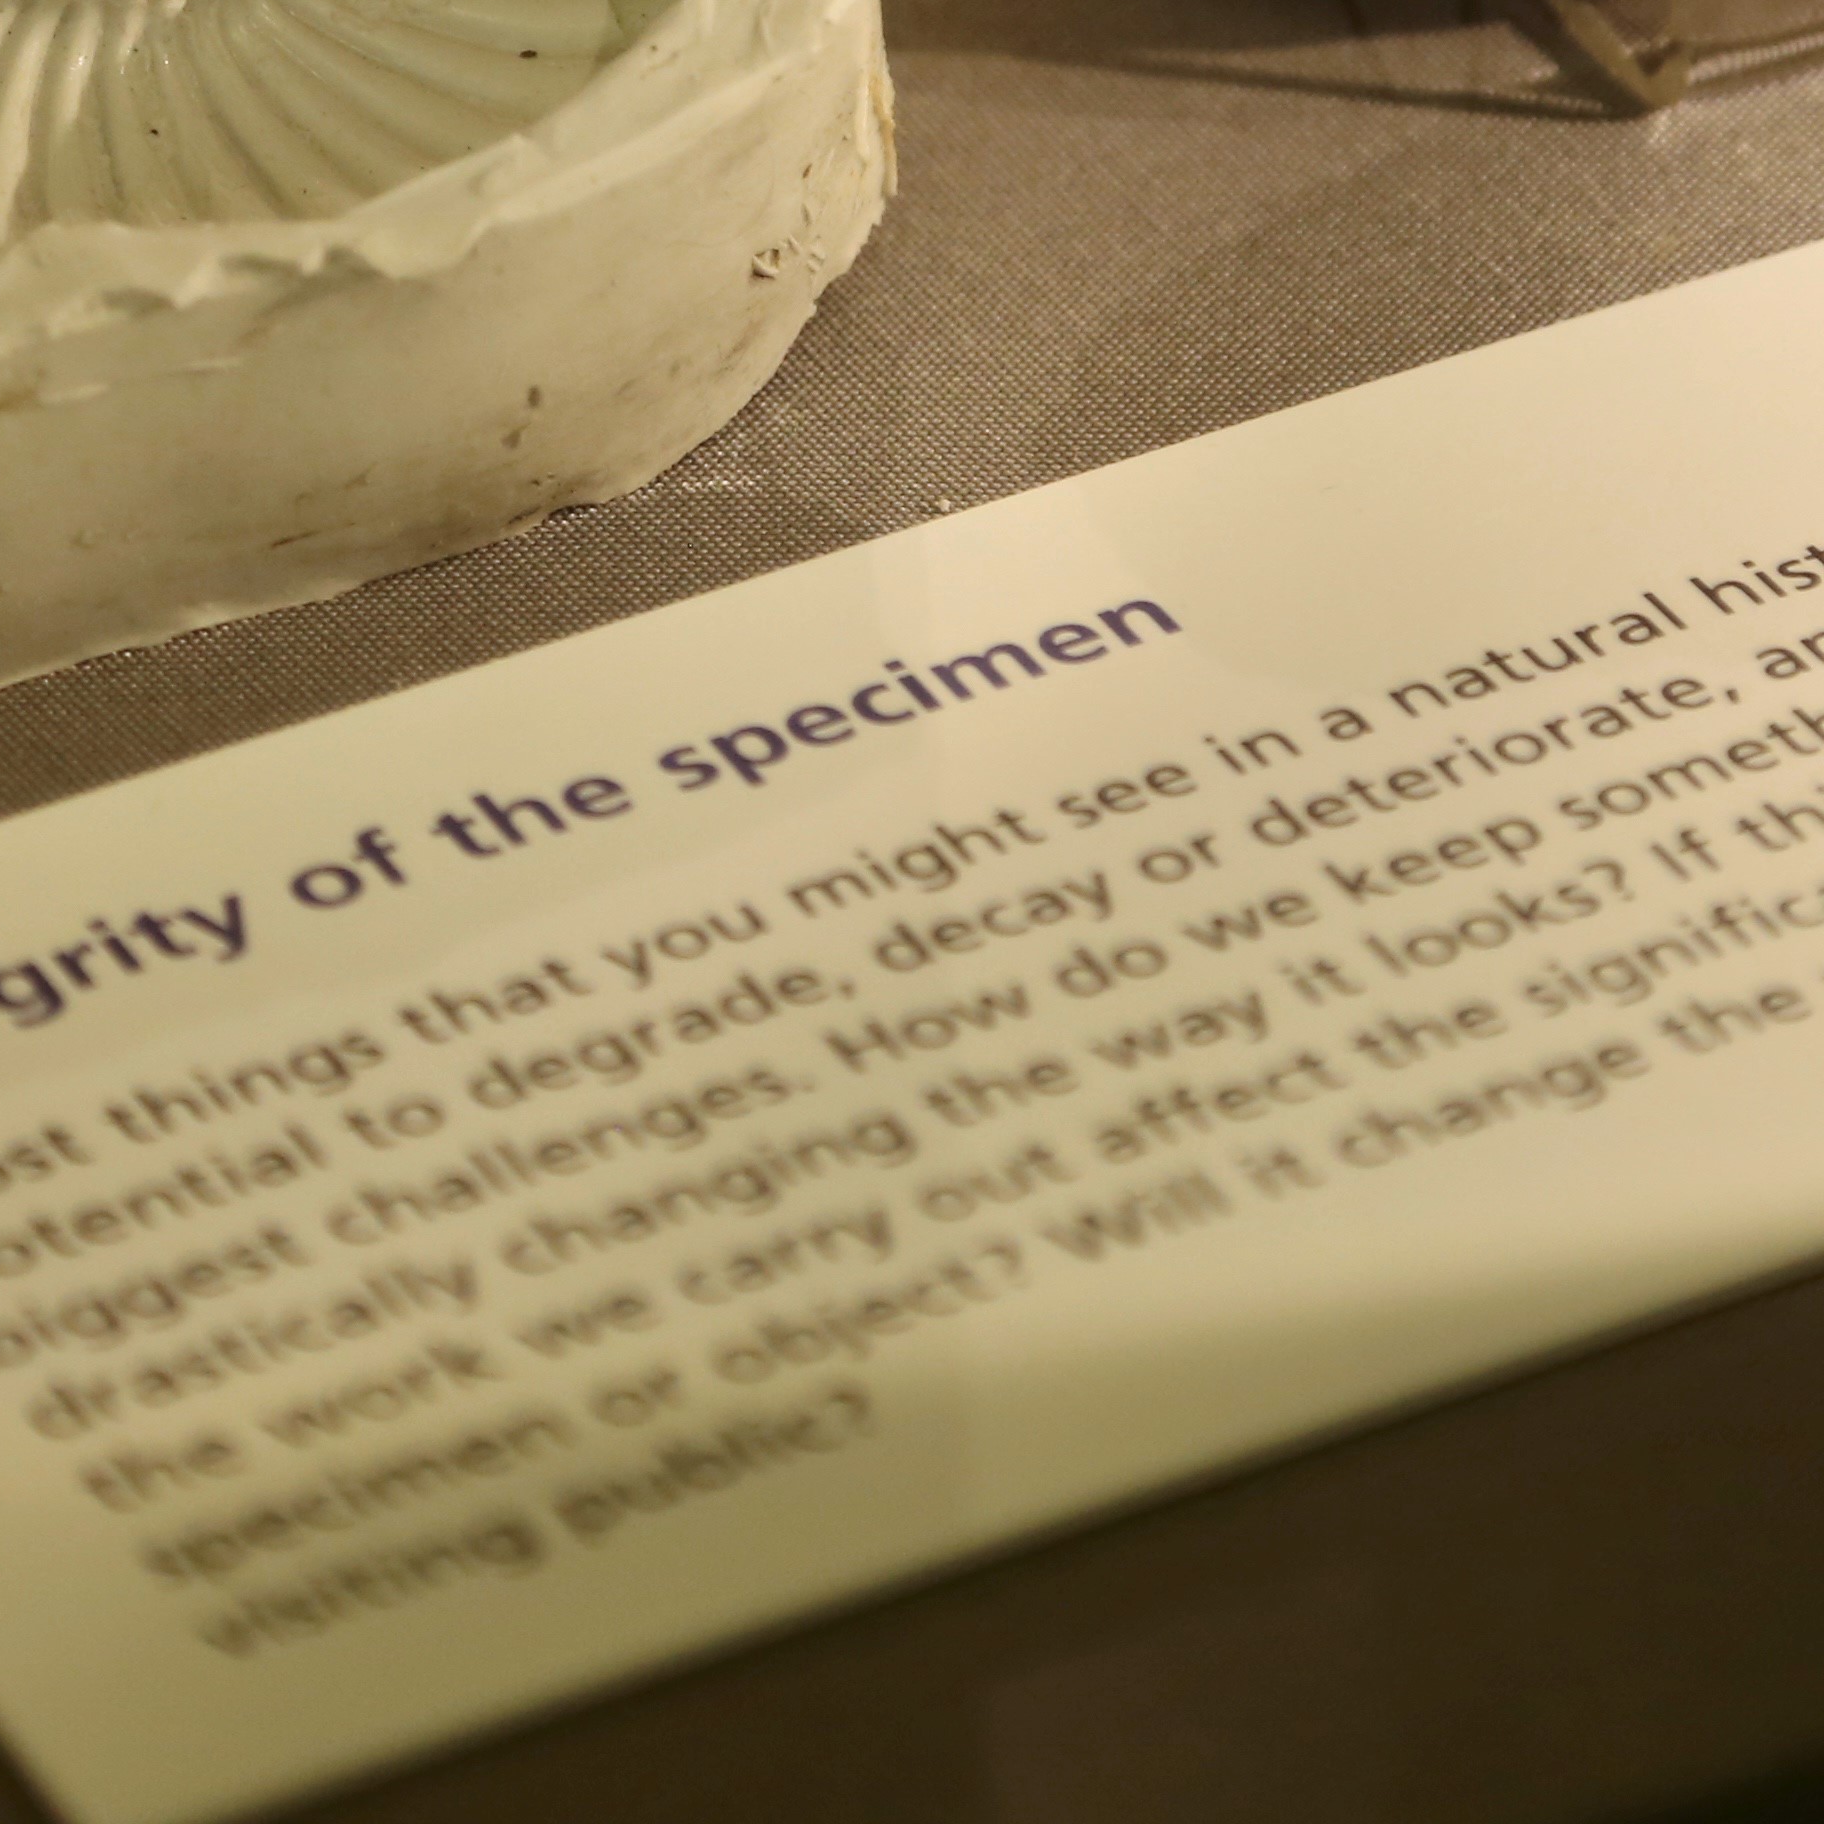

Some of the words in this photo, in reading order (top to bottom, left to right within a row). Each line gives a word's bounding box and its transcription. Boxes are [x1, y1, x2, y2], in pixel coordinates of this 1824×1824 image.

[103, 1030, 385, 1142] things
[397, 958, 588, 1043] that
[601, 902, 768, 988] you
[786, 809, 1044, 915] might
[1056, 763, 1196, 828] see
[1203, 729, 1301, 774] in
[1319, 706, 1372, 741] a
[1387, 591, 1686, 716] natural
[289, 826, 405, 908] of
[432, 776, 631, 858] the
[658, 599, 1179, 790] specimen
[341, 1094, 446, 1149] to
[467, 968, 854, 1108] degrade,
[872, 871, 1113, 972] decay
[1135, 832, 1219, 883] or
[1248, 677, 1738, 846] deteriorate,
[27, 1260, 478, 1438] drastically
[501, 1110, 918, 1273] changing
[921, 1055, 1075, 1125] the
[1090, 990, 1269, 1069] way
[1279, 956, 1362, 1003] it
[1363, 857, 1631, 974] looks?
[1648, 826, 1718, 879] If
[79, 1432, 238, 1511] the
[262, 1340, 495, 1446] work
[516, 1287, 653, 1356] we
[676, 1206, 895, 1302] carry
[914, 1139, 1073, 1221] out
[1093, 1050, 1341, 1162] affect
[1351, 1000, 1501, 1068] the
[326, 1066, 818, 1243] challenges.
[822, 983, 1030, 1072] How
[1052, 939, 1169, 998] do
[1181, 889, 1317, 951] we
[1322, 816, 1542, 902] keep
[142, 1414, 564, 1582] specimen
[590, 1365, 680, 1426] or
[712, 1237, 1022, 1381] object?
[1040, 1169, 1229, 1260] Will
[1238, 1144, 1319, 1195] it
[1334, 1039, 1645, 1166] change
[1656, 984, 1809, 1052] the
[201, 1510, 548, 1656] visiting
[552, 1384, 870, 1543] public?
